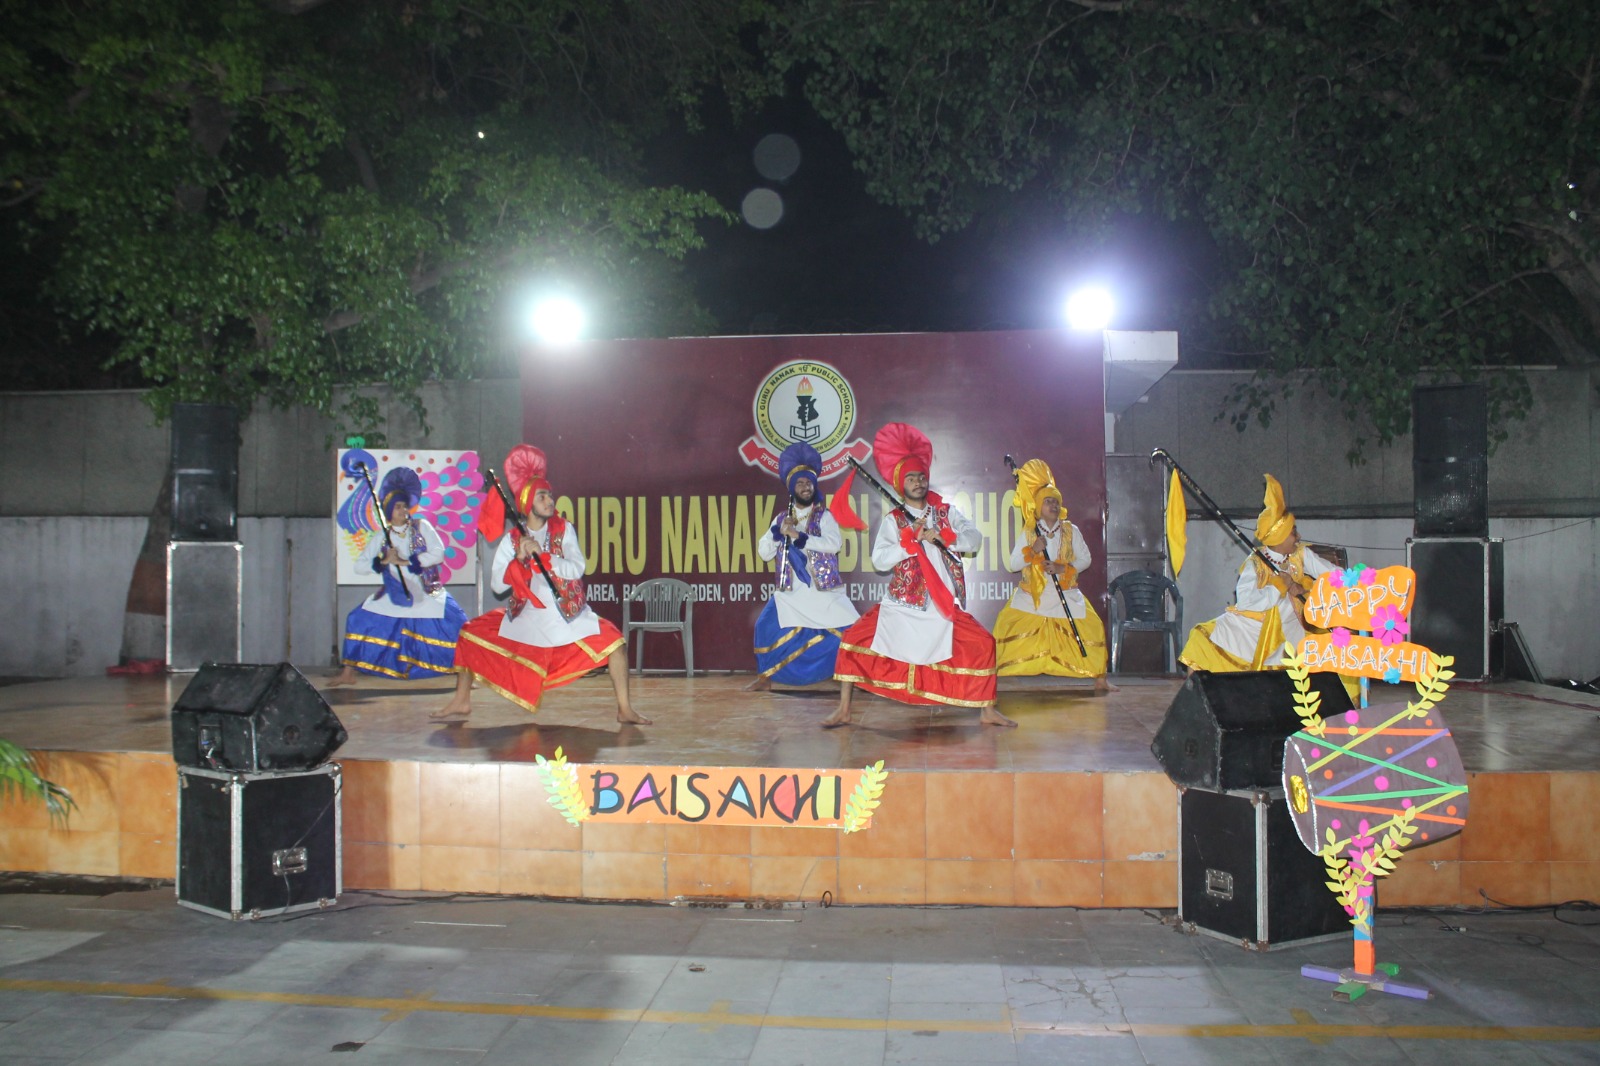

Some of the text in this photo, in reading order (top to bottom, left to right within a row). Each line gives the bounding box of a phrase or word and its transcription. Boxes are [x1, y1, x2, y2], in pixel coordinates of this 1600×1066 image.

[759, 388, 770, 411] GURU
[770, 367, 795, 386] NANAK
[811, 366, 839, 384] PUBLIC
[837, 383, 850, 415] SCHOOL
[661, 495, 776, 573] NANAK
[586, 583, 619, 604] AREA,
[729, 583, 756, 601] OPP.
[1307, 575, 1412, 627] HAPPY
[1303, 640, 1428, 675] BAISAKHI
[590, 770, 842, 823] BAISAKHI
